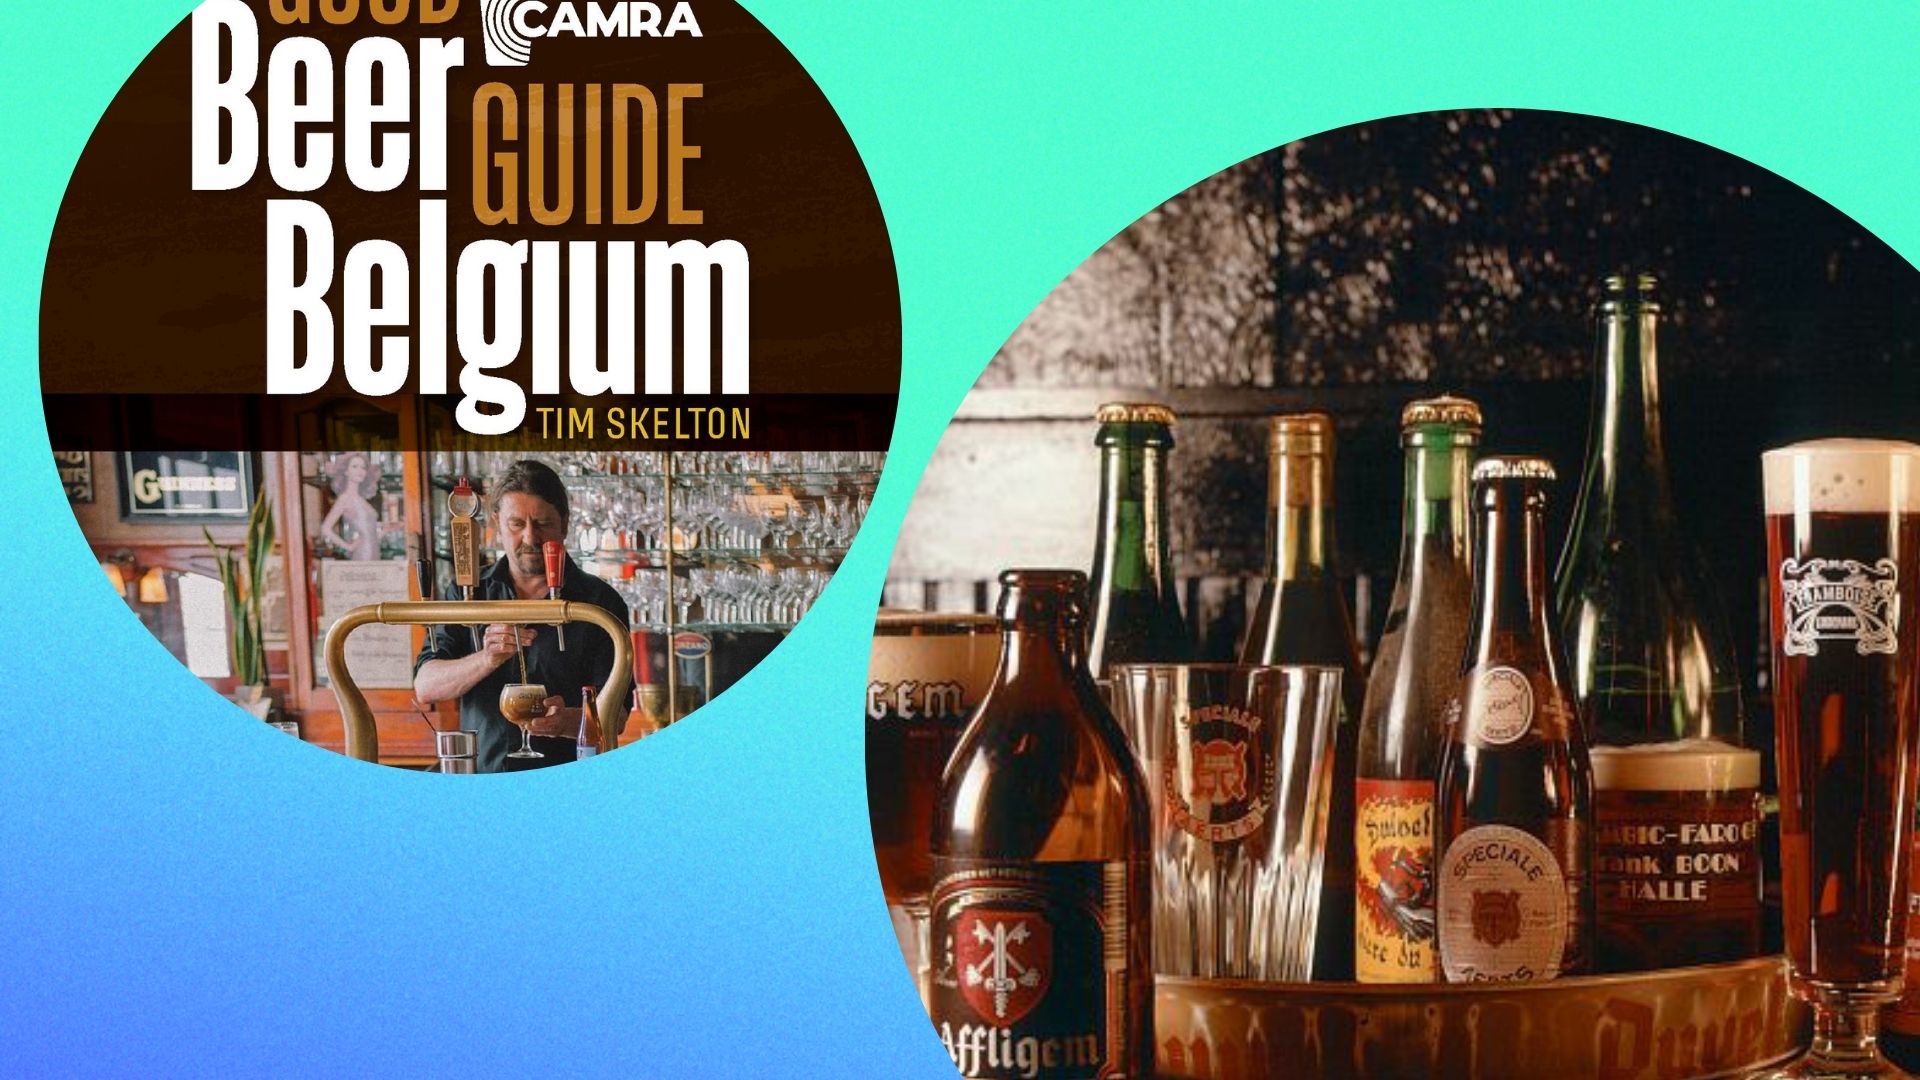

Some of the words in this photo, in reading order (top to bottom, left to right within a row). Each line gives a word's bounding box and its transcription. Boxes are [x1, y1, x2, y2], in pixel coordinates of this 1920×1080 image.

[514, 1, 703, 38] CAMRA
[191, 0, 464, 192] Beer
[472, 82, 704, 226] GUIDE
[266, 199, 750, 435] Belgium
[536, 407, 594, 439] TIM
[606, 407, 750, 439] SKELTON
[1598, 823, 1739, 846] AGIC-FARO
[1453, 842, 1544, 881] SPECIALE
[1619, 879, 1708, 901] HALLE
